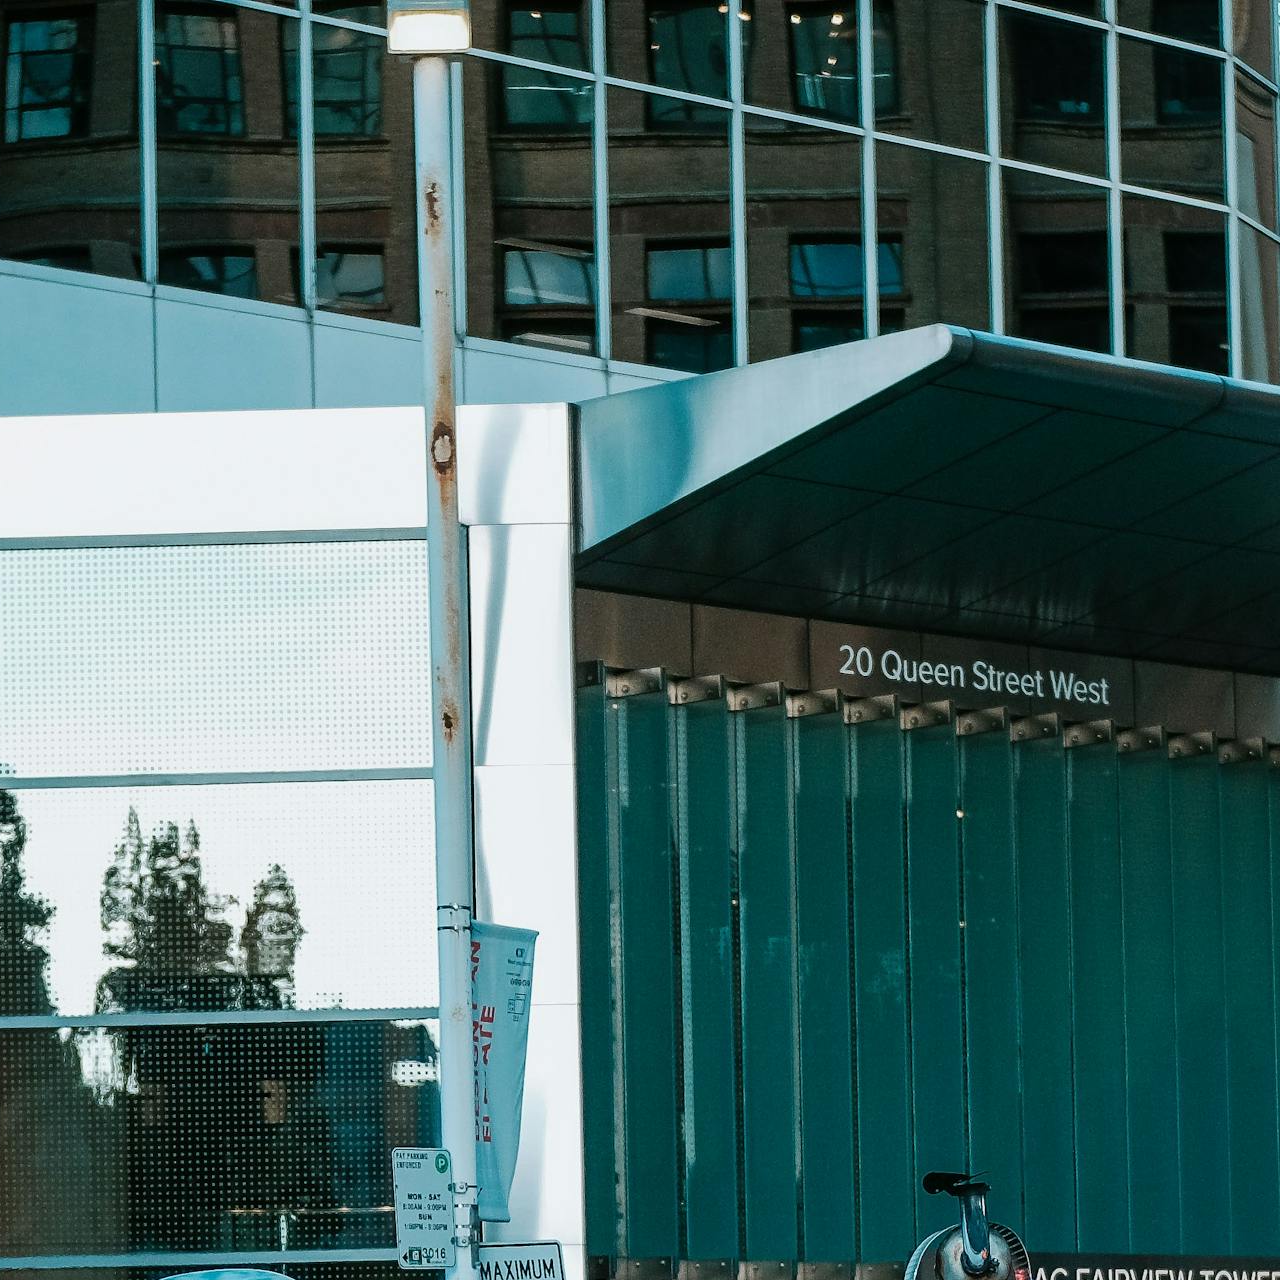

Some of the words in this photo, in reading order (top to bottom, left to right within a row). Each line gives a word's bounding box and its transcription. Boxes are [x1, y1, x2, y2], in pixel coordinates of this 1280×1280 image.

[839, 644, 873, 677] 20
[881, 650, 965, 688] Queen
[972, 660, 1045, 698] Street
[1049, 669, 1110, 705] West
[418, 1213, 433, 1221] SUN
[422, 1247, 446, 1259] 3016
